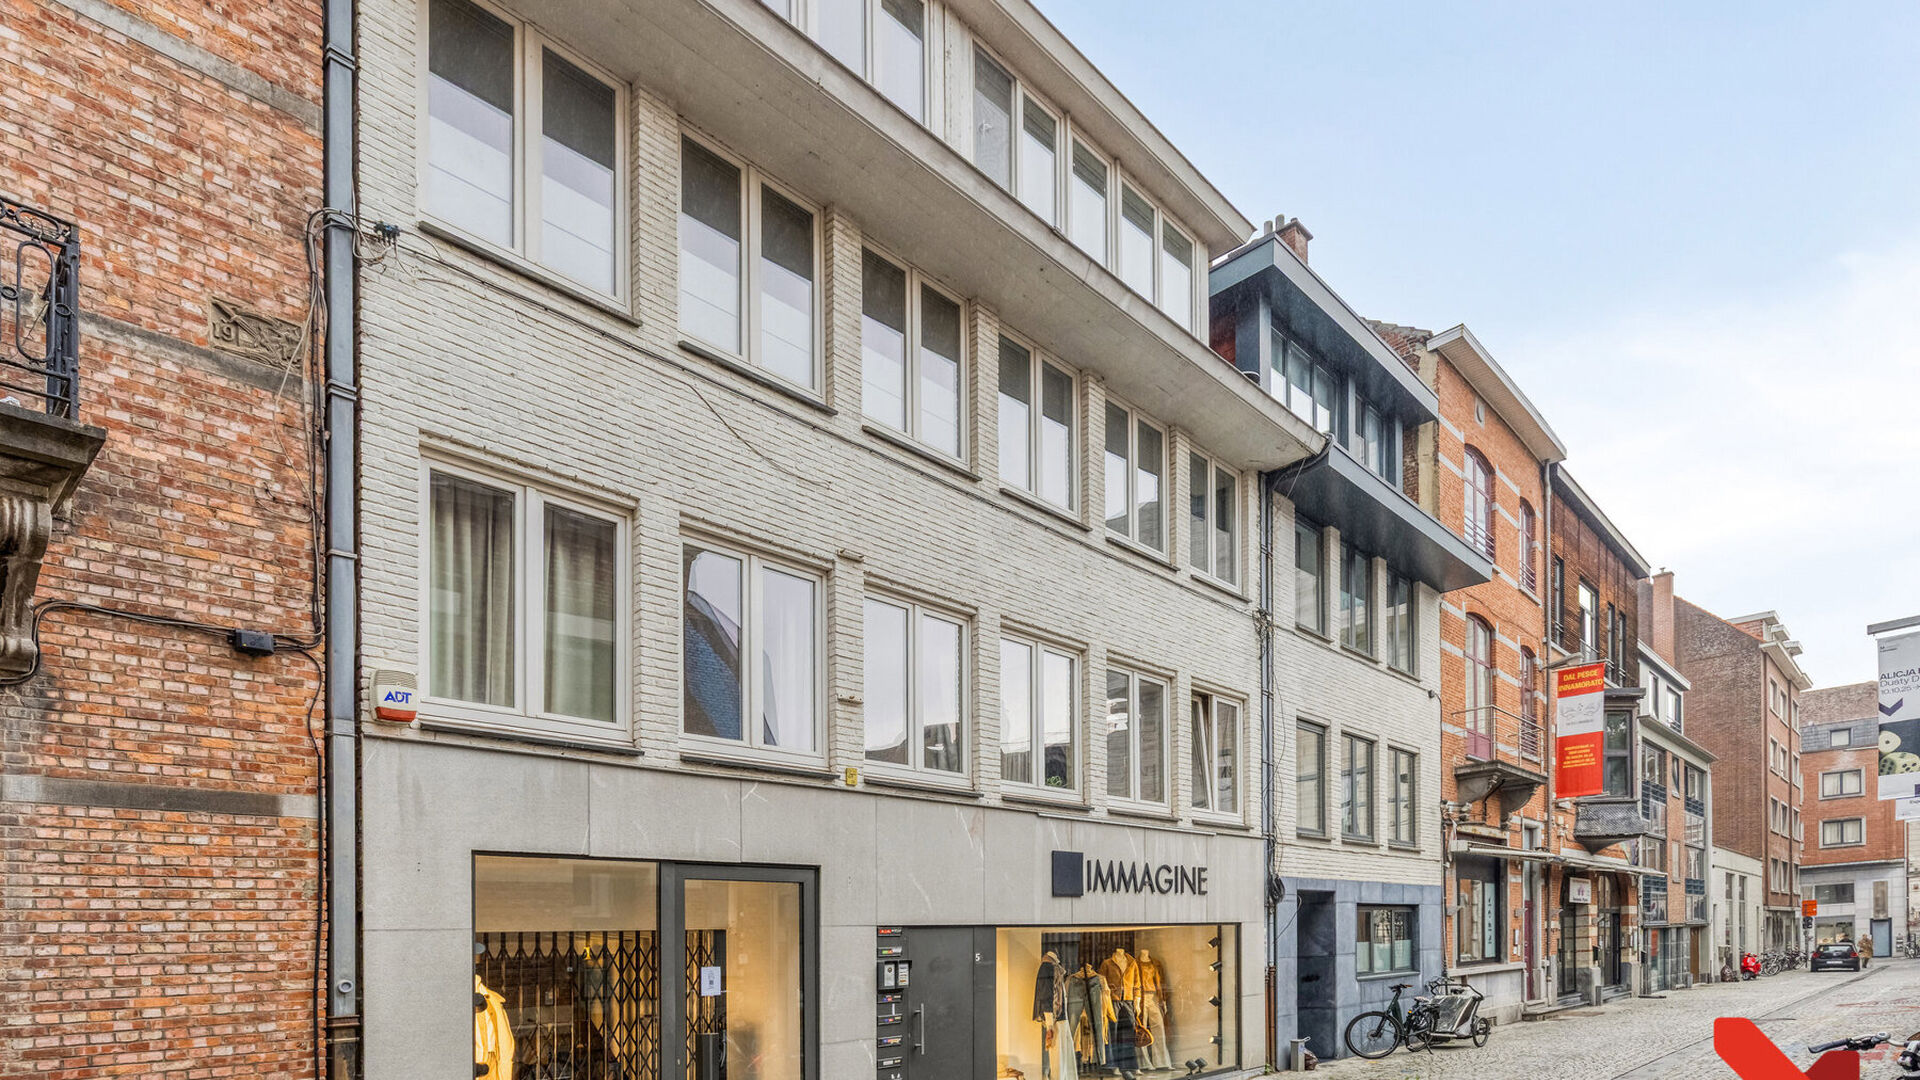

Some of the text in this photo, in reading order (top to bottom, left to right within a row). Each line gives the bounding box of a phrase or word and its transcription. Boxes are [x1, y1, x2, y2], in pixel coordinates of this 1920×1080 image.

[1563, 669, 1598, 681] DAL PESCE
[1880, 668, 1916, 680] ALICJA
[1558, 678, 1603, 692] INNAMORATO
[1880, 677, 1909, 687] Dusty
[384, 691, 412, 704] ADT
[1086, 859, 1208, 896] IMMAGINE
[975, 953, 981, 962] 5
